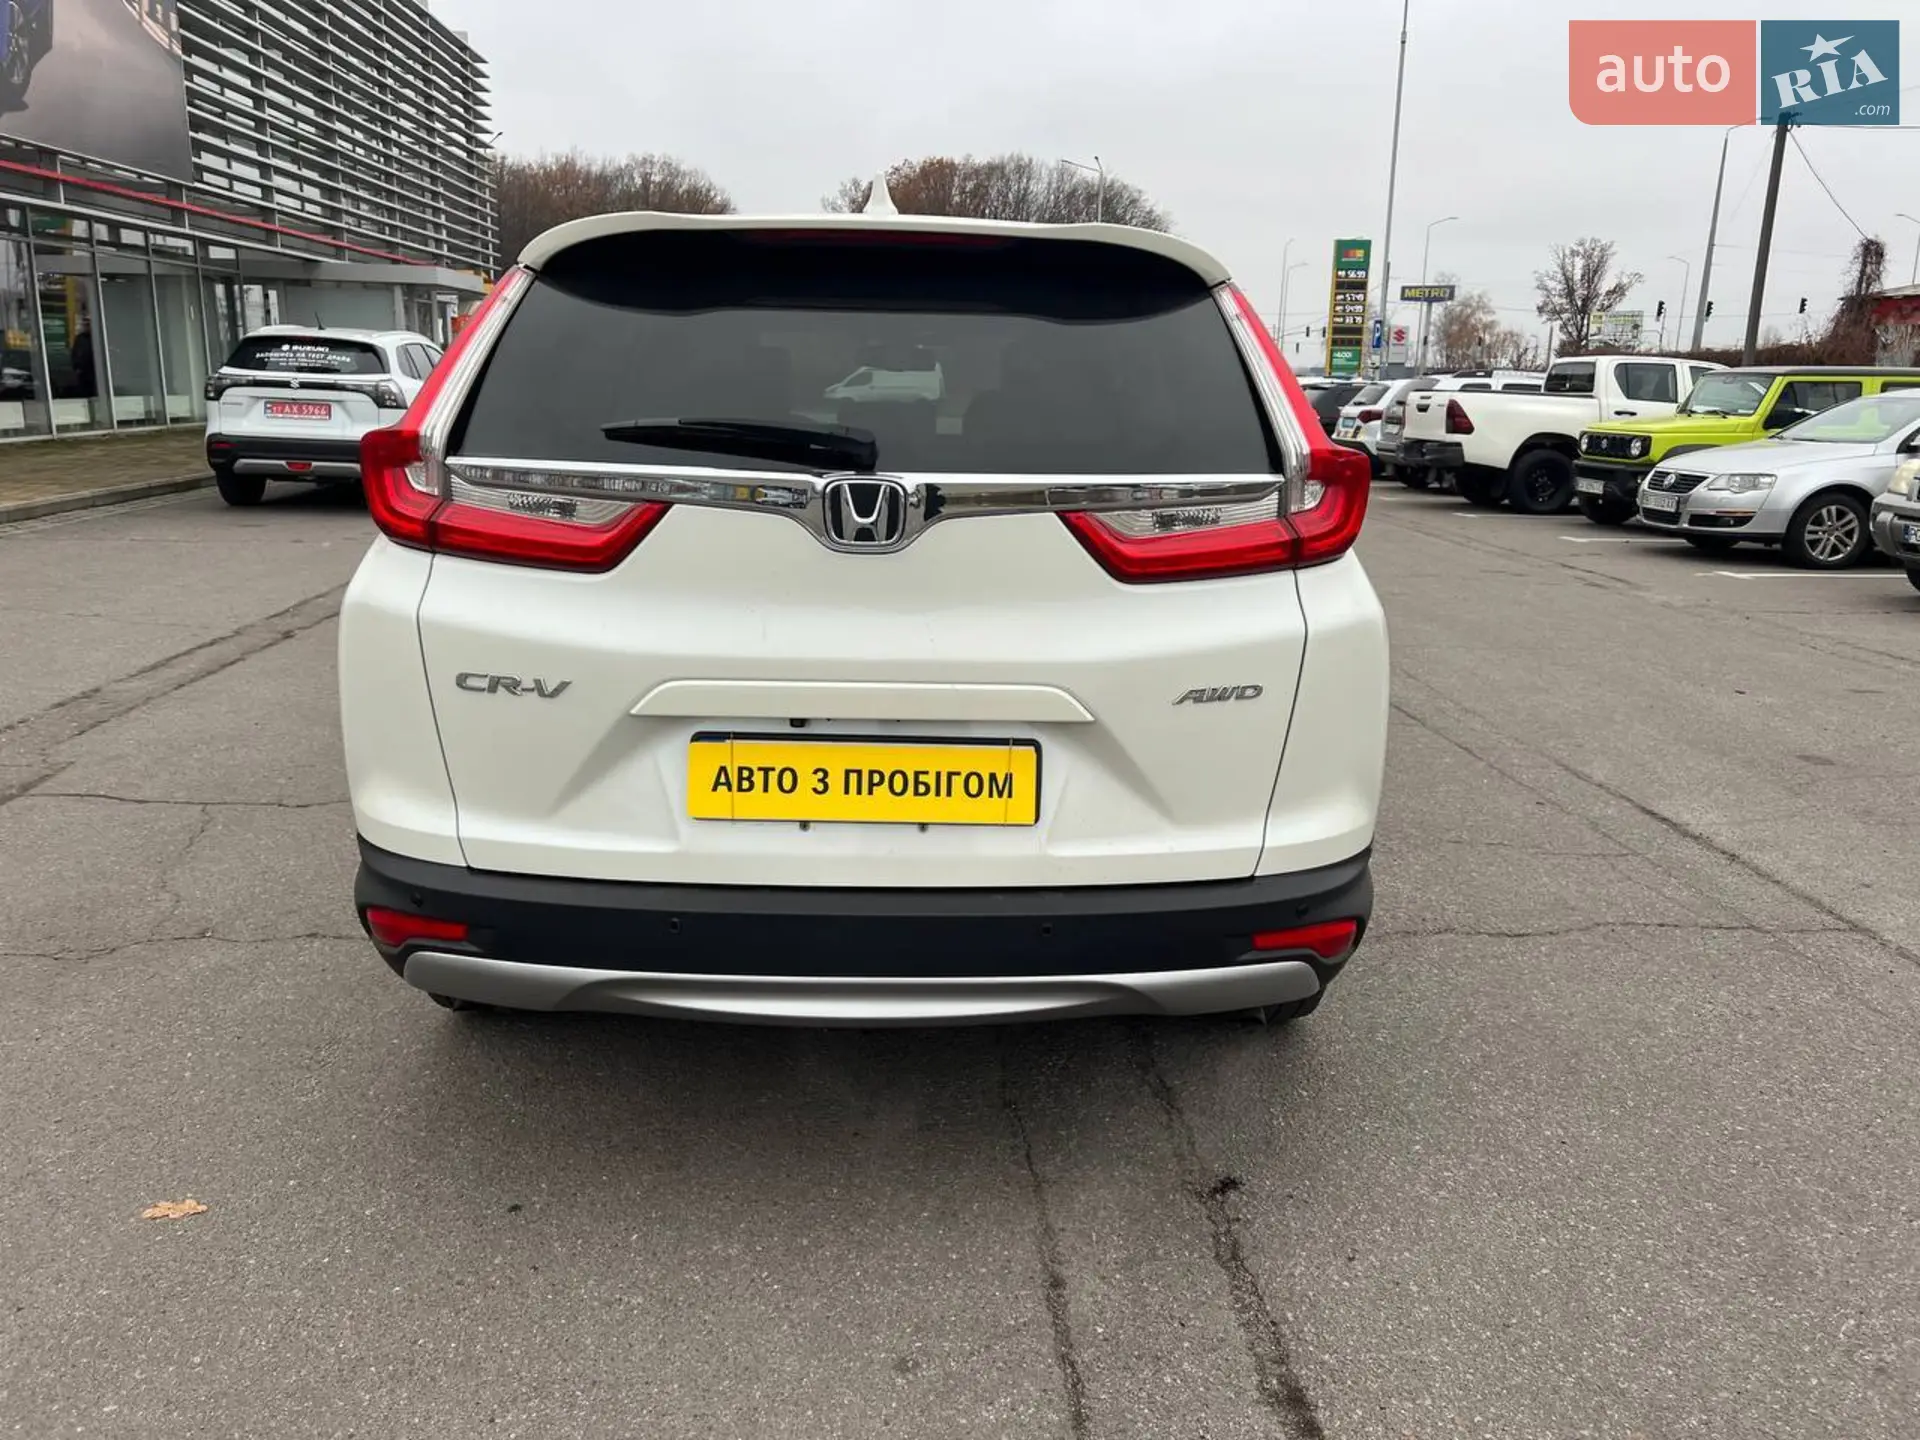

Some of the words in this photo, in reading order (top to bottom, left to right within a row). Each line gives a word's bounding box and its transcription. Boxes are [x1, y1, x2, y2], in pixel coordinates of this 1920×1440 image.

[1404, 288, 1450, 298] METRO
[455, 672, 573, 699] CR-V
[1171, 684, 1264, 706] AWD
[711, 765, 799, 795] АВТО
[843, 768, 1014, 799] ПРОБІГОМ
